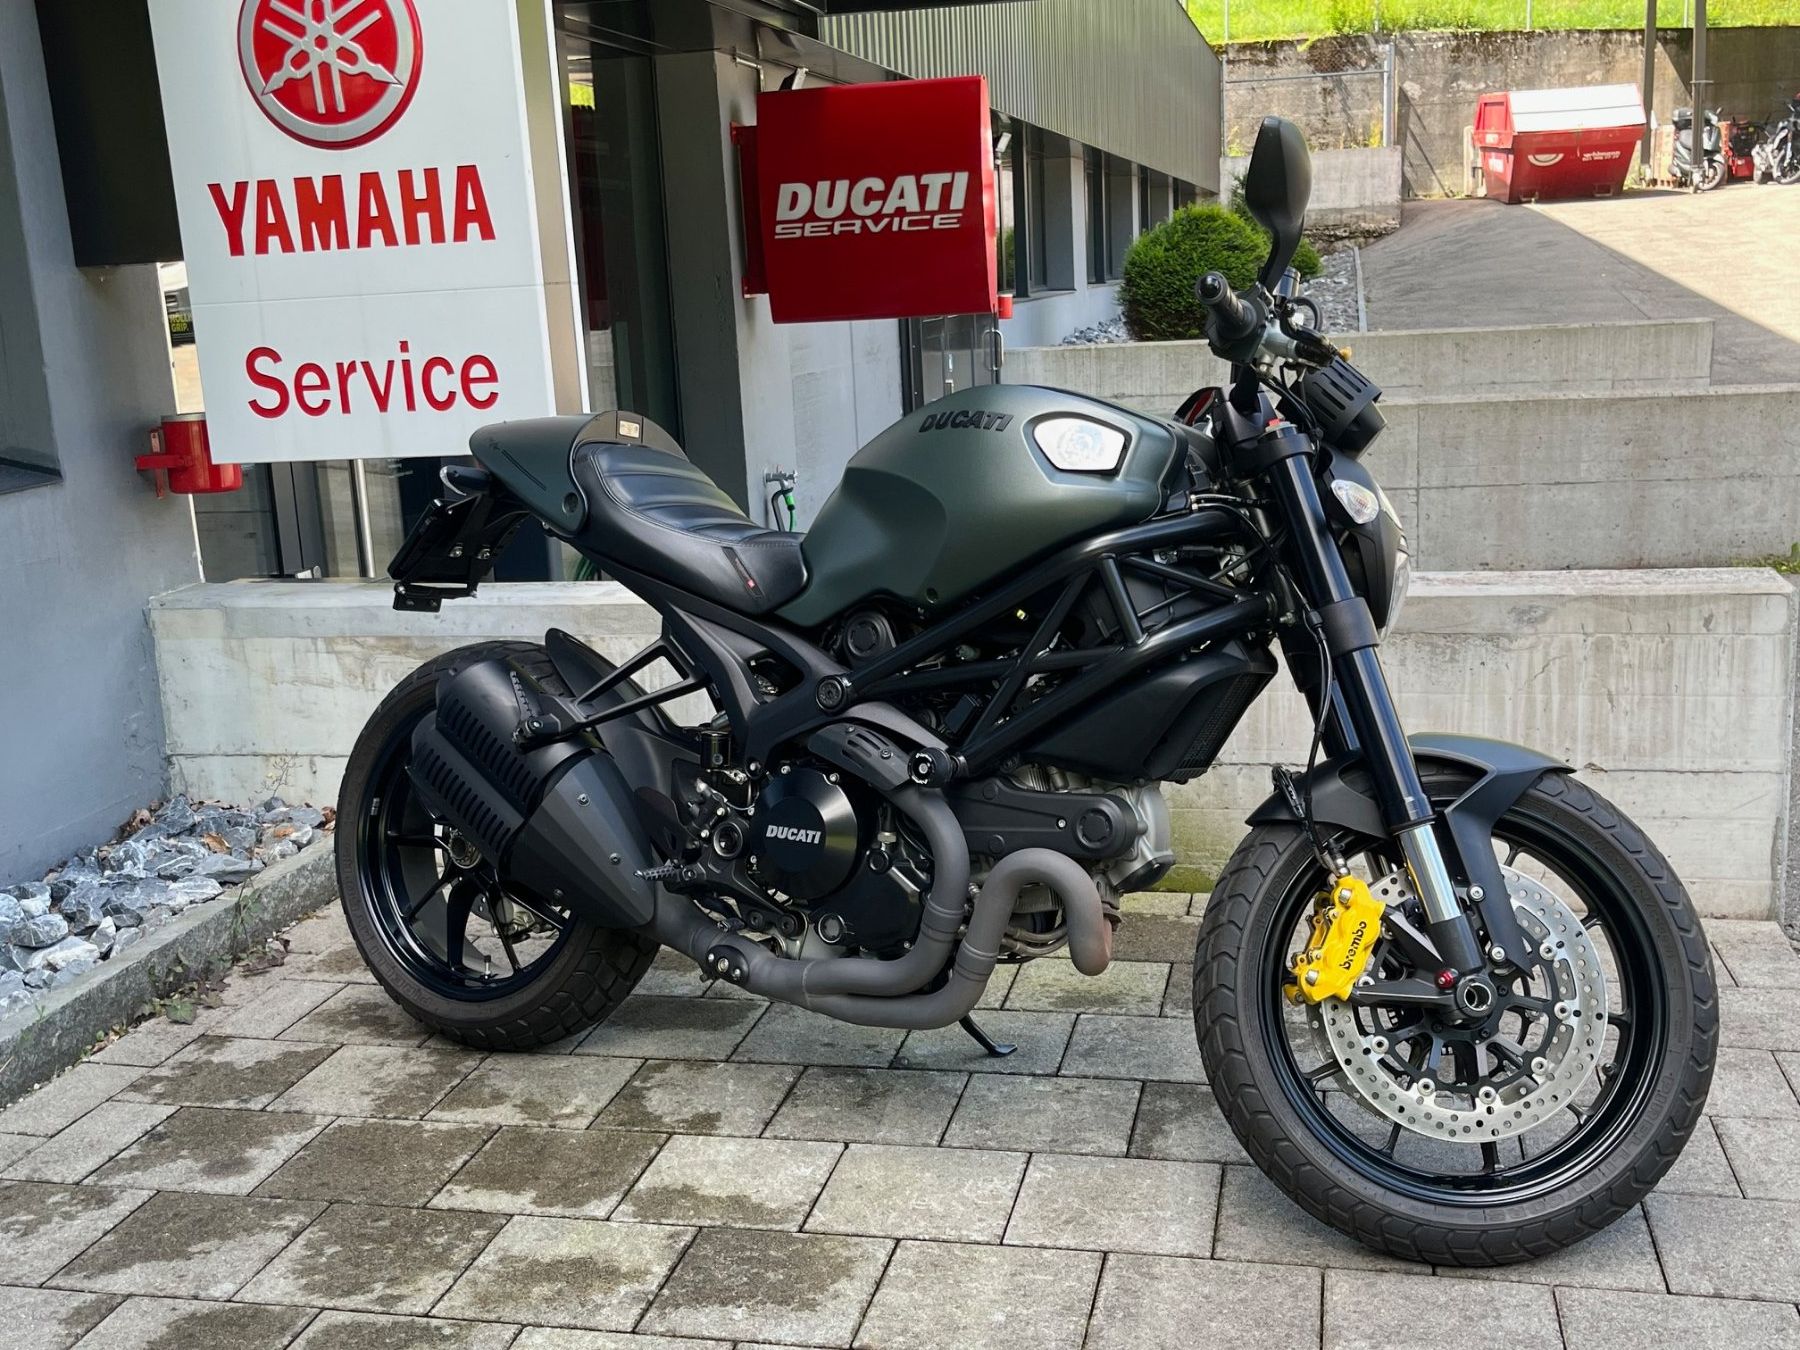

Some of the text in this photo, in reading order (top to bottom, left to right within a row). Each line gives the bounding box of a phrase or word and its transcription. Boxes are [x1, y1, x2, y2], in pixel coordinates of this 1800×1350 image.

[207, 164, 496, 257] YAMAHA
[776, 171, 969, 221] DUCATI
[774, 213, 963, 239] SERVICE
[245, 340, 499, 419] Service
[919, 410, 1014, 432] DUCATI
[766, 825, 821, 844] DUCATI
[1339, 921, 1367, 970] brembo
